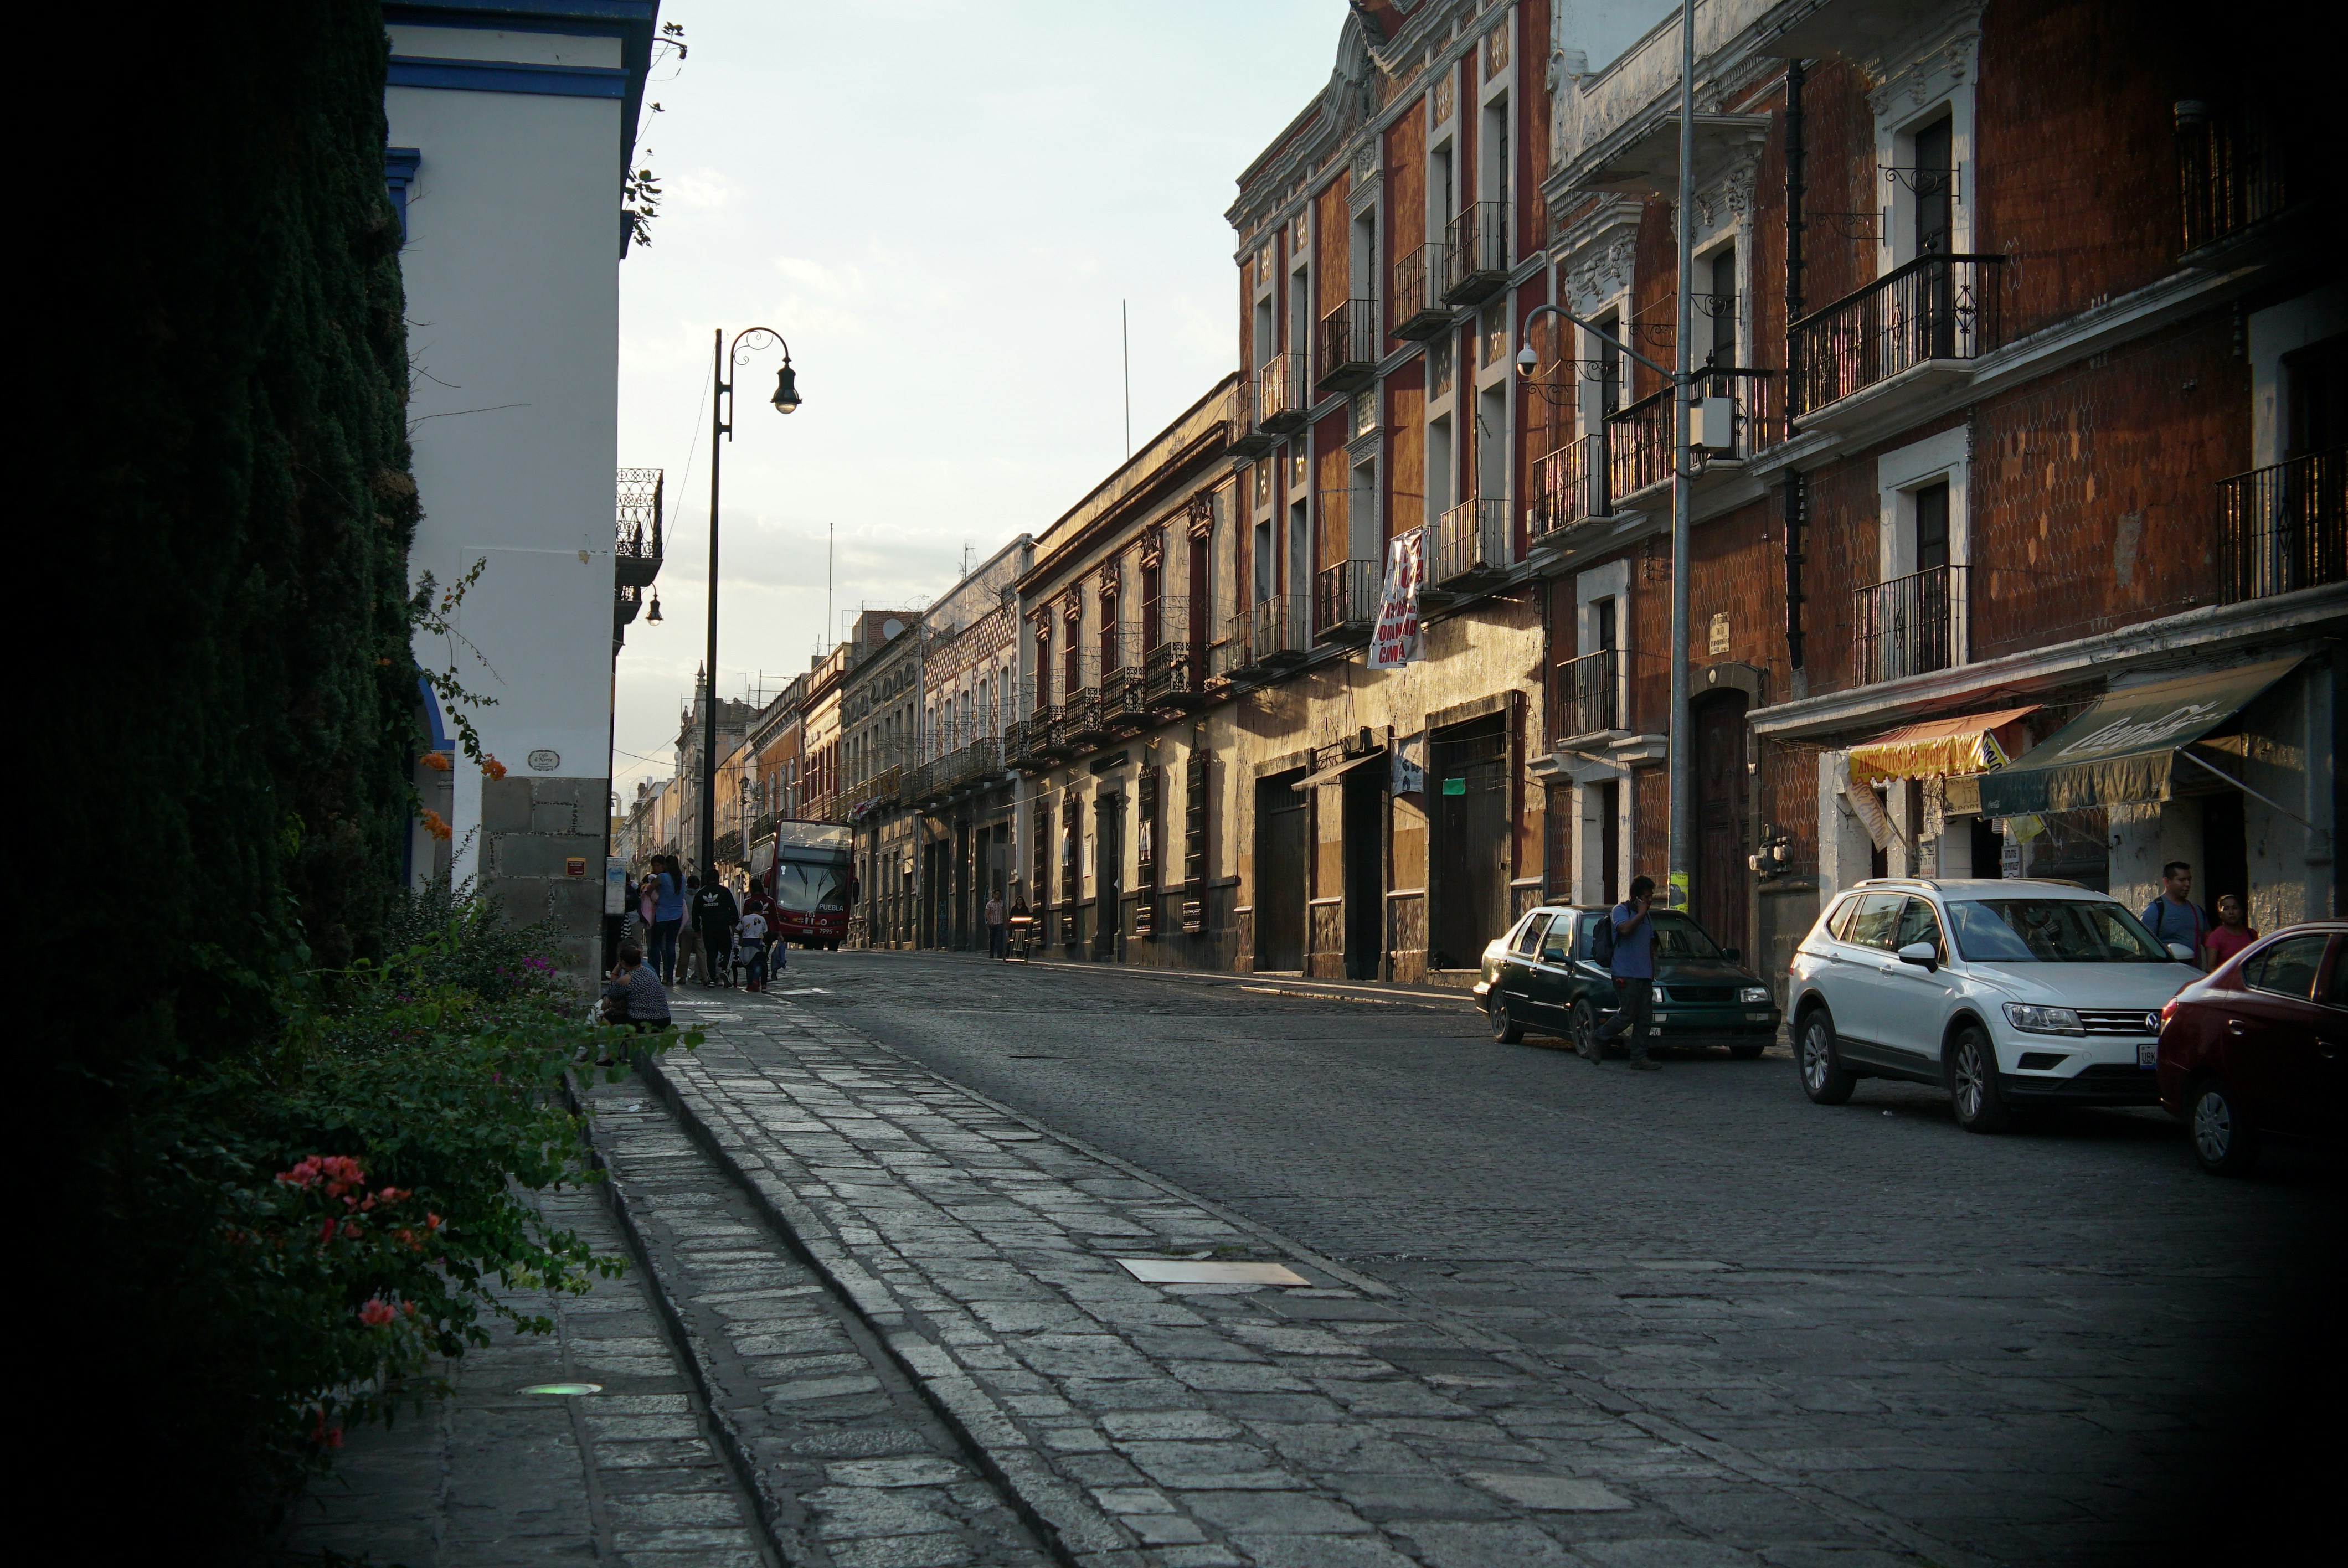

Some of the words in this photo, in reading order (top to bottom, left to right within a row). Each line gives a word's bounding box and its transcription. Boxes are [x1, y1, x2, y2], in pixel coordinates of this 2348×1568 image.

[1858, 750, 1902, 773] ANTOJITOS
[819, 903, 844, 911] PUEBLA
[2141, 1052, 2155, 1062] UBK
